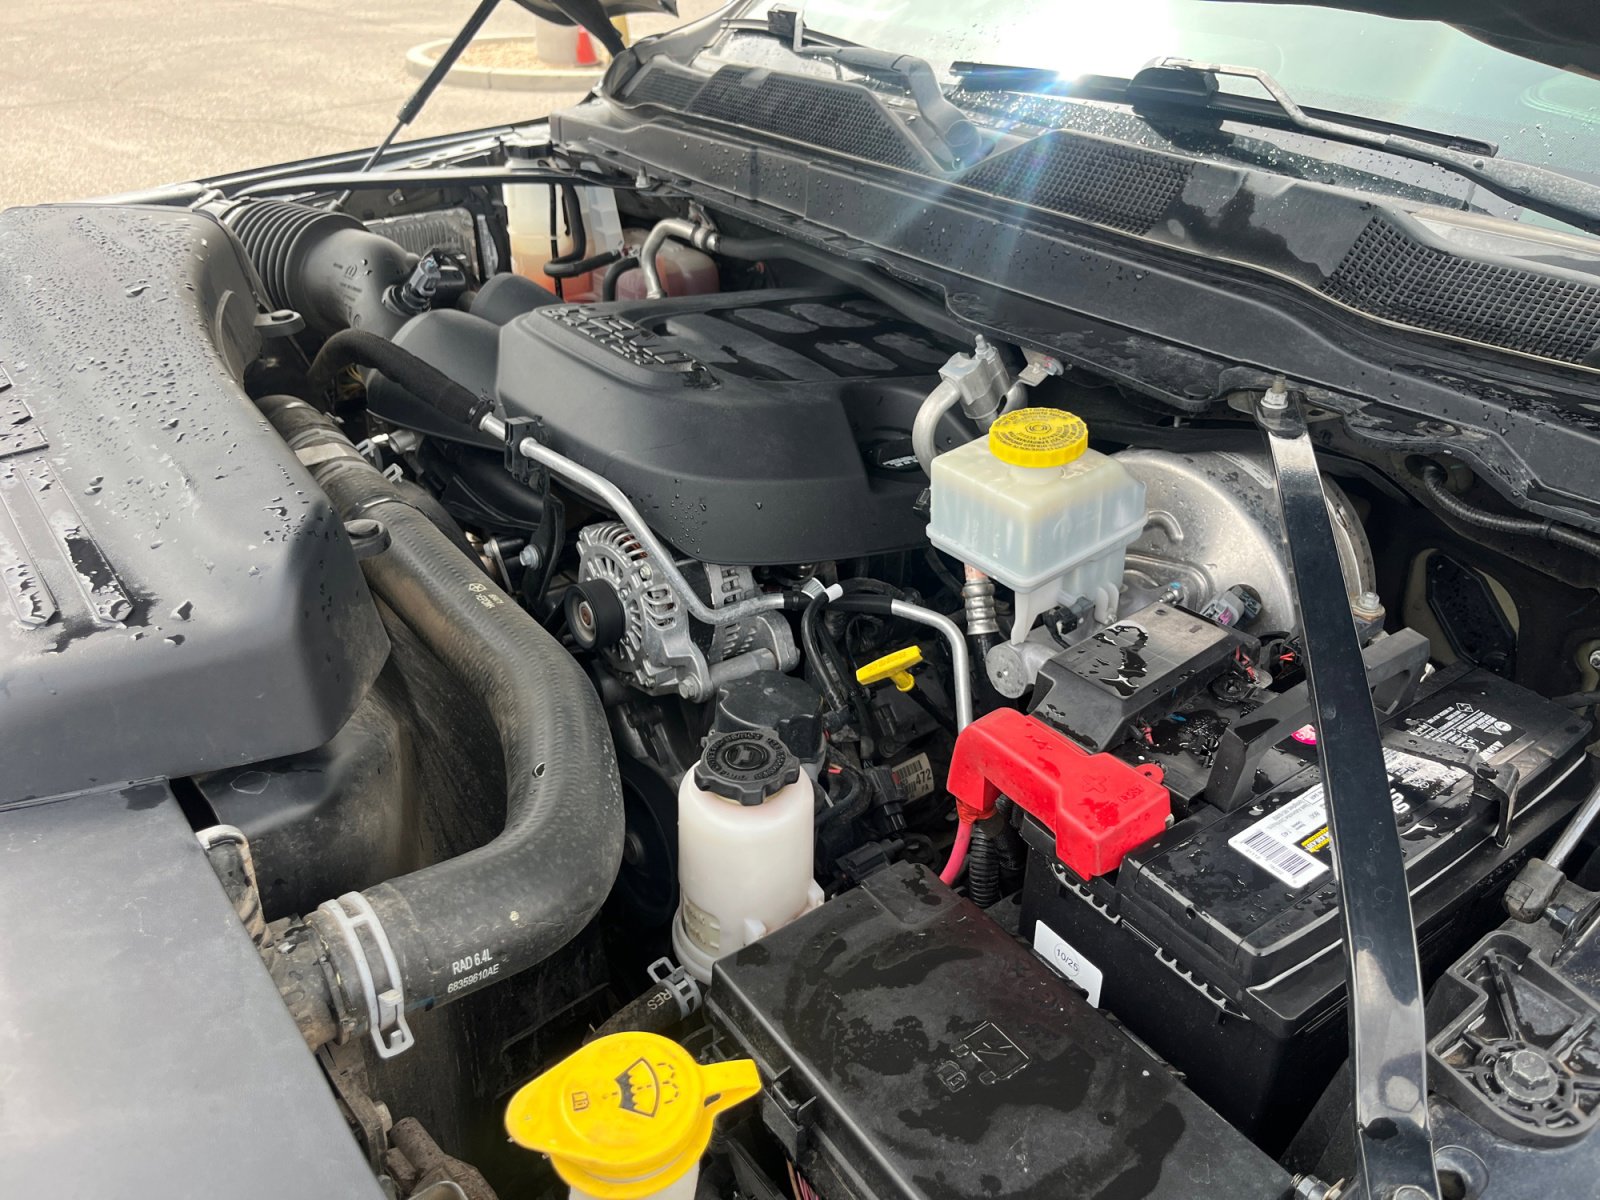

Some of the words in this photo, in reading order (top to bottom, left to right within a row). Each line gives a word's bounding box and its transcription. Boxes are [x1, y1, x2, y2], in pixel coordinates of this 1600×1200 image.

[452, 956, 473, 975] RAD
[474, 948, 493, 966] 6.4L
[1056, 948, 1079, 972] 10/25
[447, 963, 500, 994] 68359610AE
[647, 988, 673, 1010] RES
